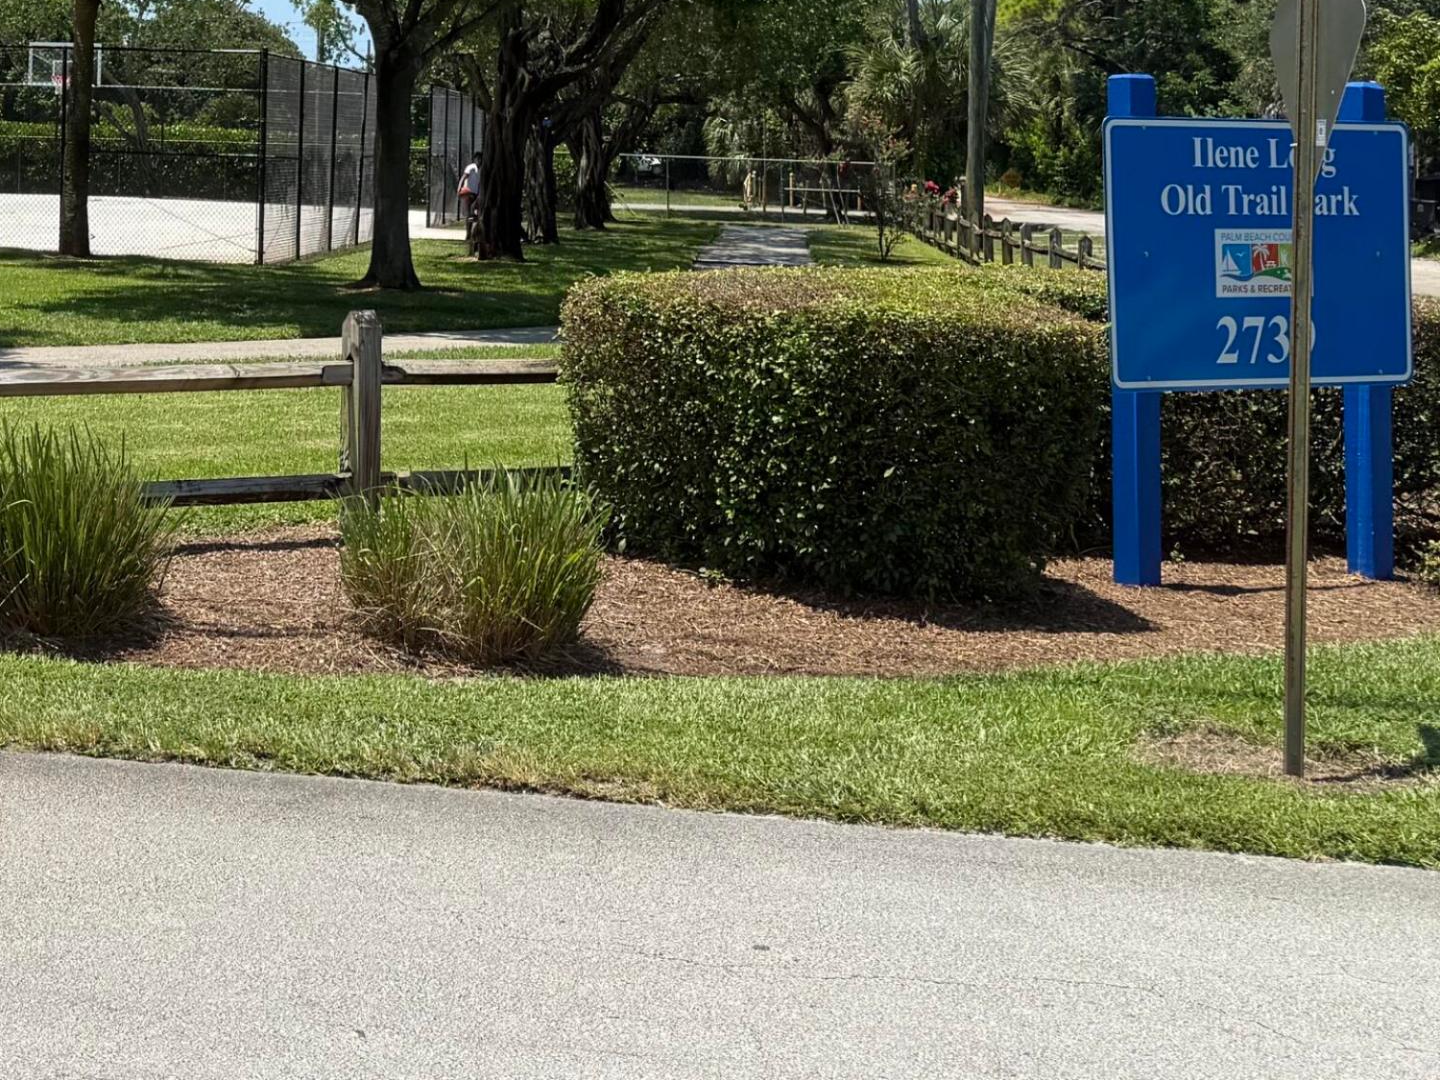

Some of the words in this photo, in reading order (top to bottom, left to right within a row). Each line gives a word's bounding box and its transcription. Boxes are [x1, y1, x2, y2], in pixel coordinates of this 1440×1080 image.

[1192, 137, 1260, 168] Ilene
[1268, 138, 1337, 178] Lg
[1160, 184, 1213, 216] Old
[1221, 185, 1288, 216] Trail
[1313, 186, 1360, 216] ark
[1220, 232, 1242, 242] PALM
[1244, 232, 1271, 242] BEACH
[1222, 284, 1248, 294] PARKS
[1250, 285, 1256, 294] &
[1216, 315, 1316, 364] 273
